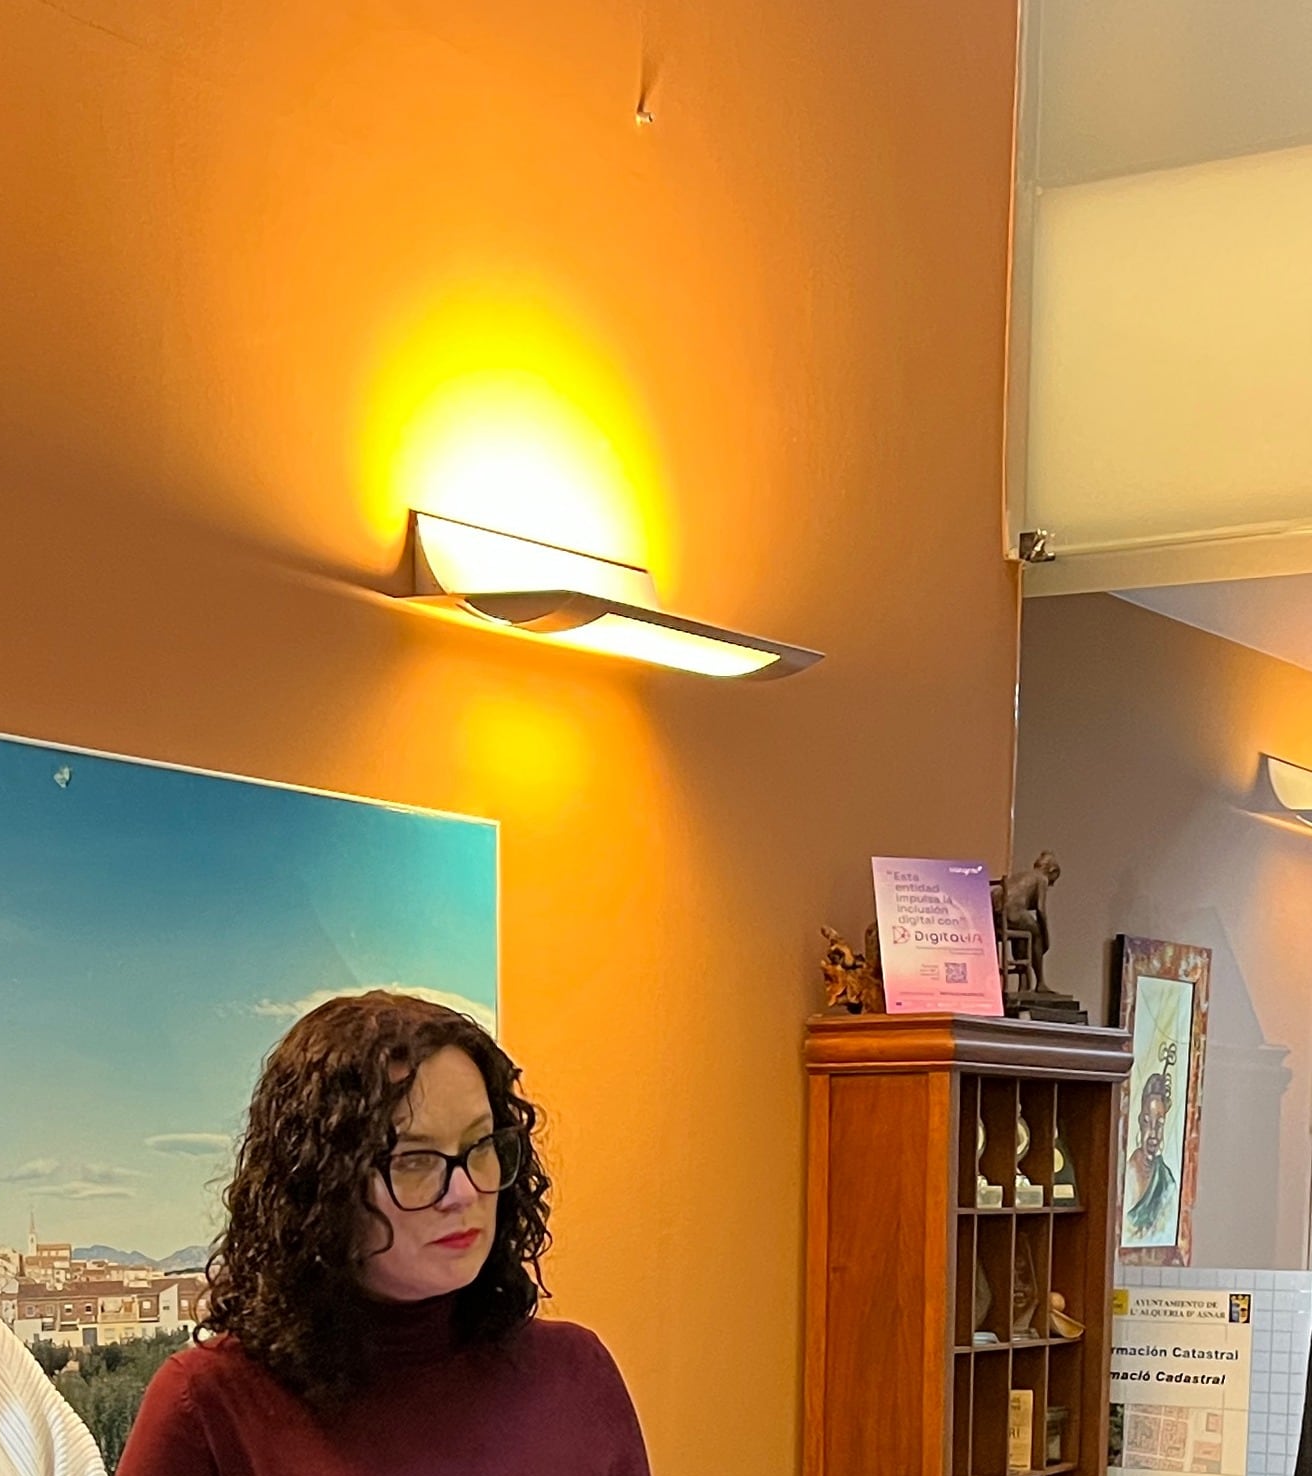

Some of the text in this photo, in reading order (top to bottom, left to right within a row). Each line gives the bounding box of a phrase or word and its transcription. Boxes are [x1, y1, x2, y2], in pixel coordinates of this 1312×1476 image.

[896, 884, 940, 892] entidad
[896, 894, 940, 904] impulsa
[898, 916, 935, 926] digital
[1135, 1299, 1218, 1309] AYUNTAMIENTO DE
[1172, 1346, 1239, 1361] Catastral
[1155, 1371, 1226, 1386] Cadastral
